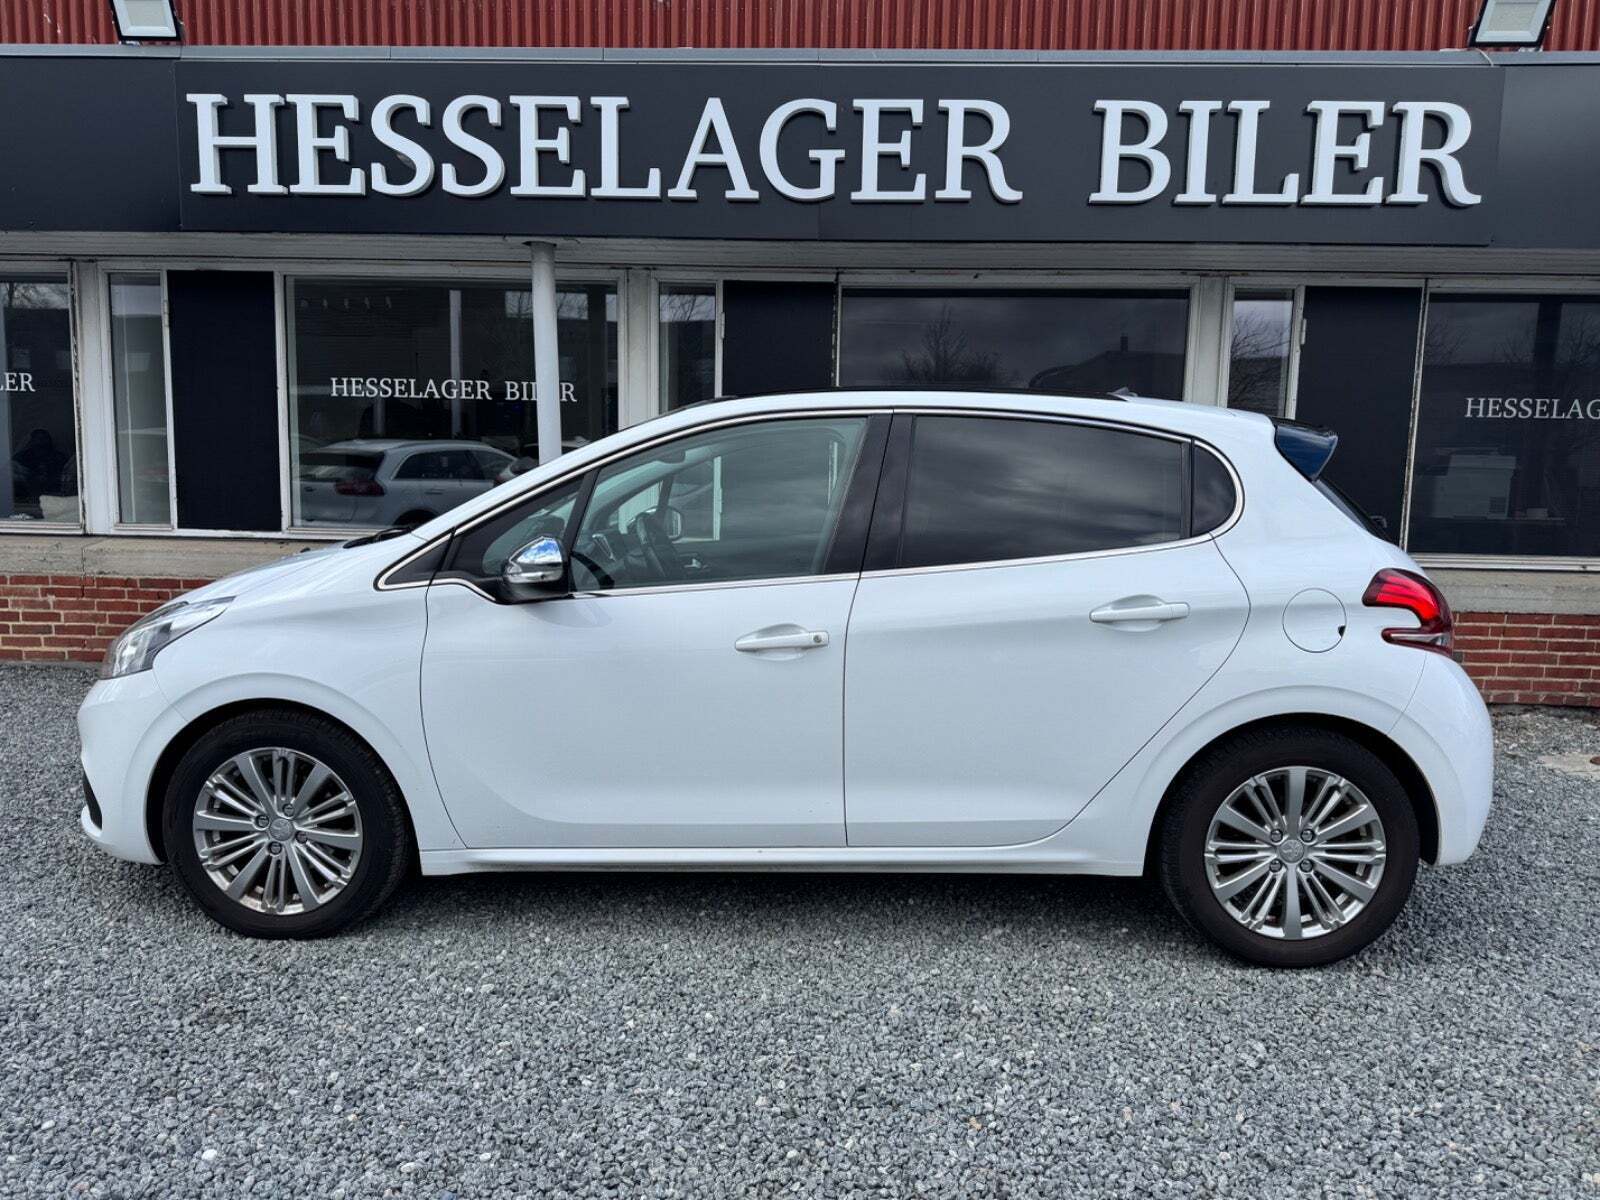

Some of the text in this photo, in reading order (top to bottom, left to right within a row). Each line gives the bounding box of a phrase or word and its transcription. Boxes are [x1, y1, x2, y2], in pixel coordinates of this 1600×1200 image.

[186, 93, 1481, 206] HESSELAGER BILER
[0, 372, 36, 392] ER
[330, 377, 492, 400] HESSELAGER
